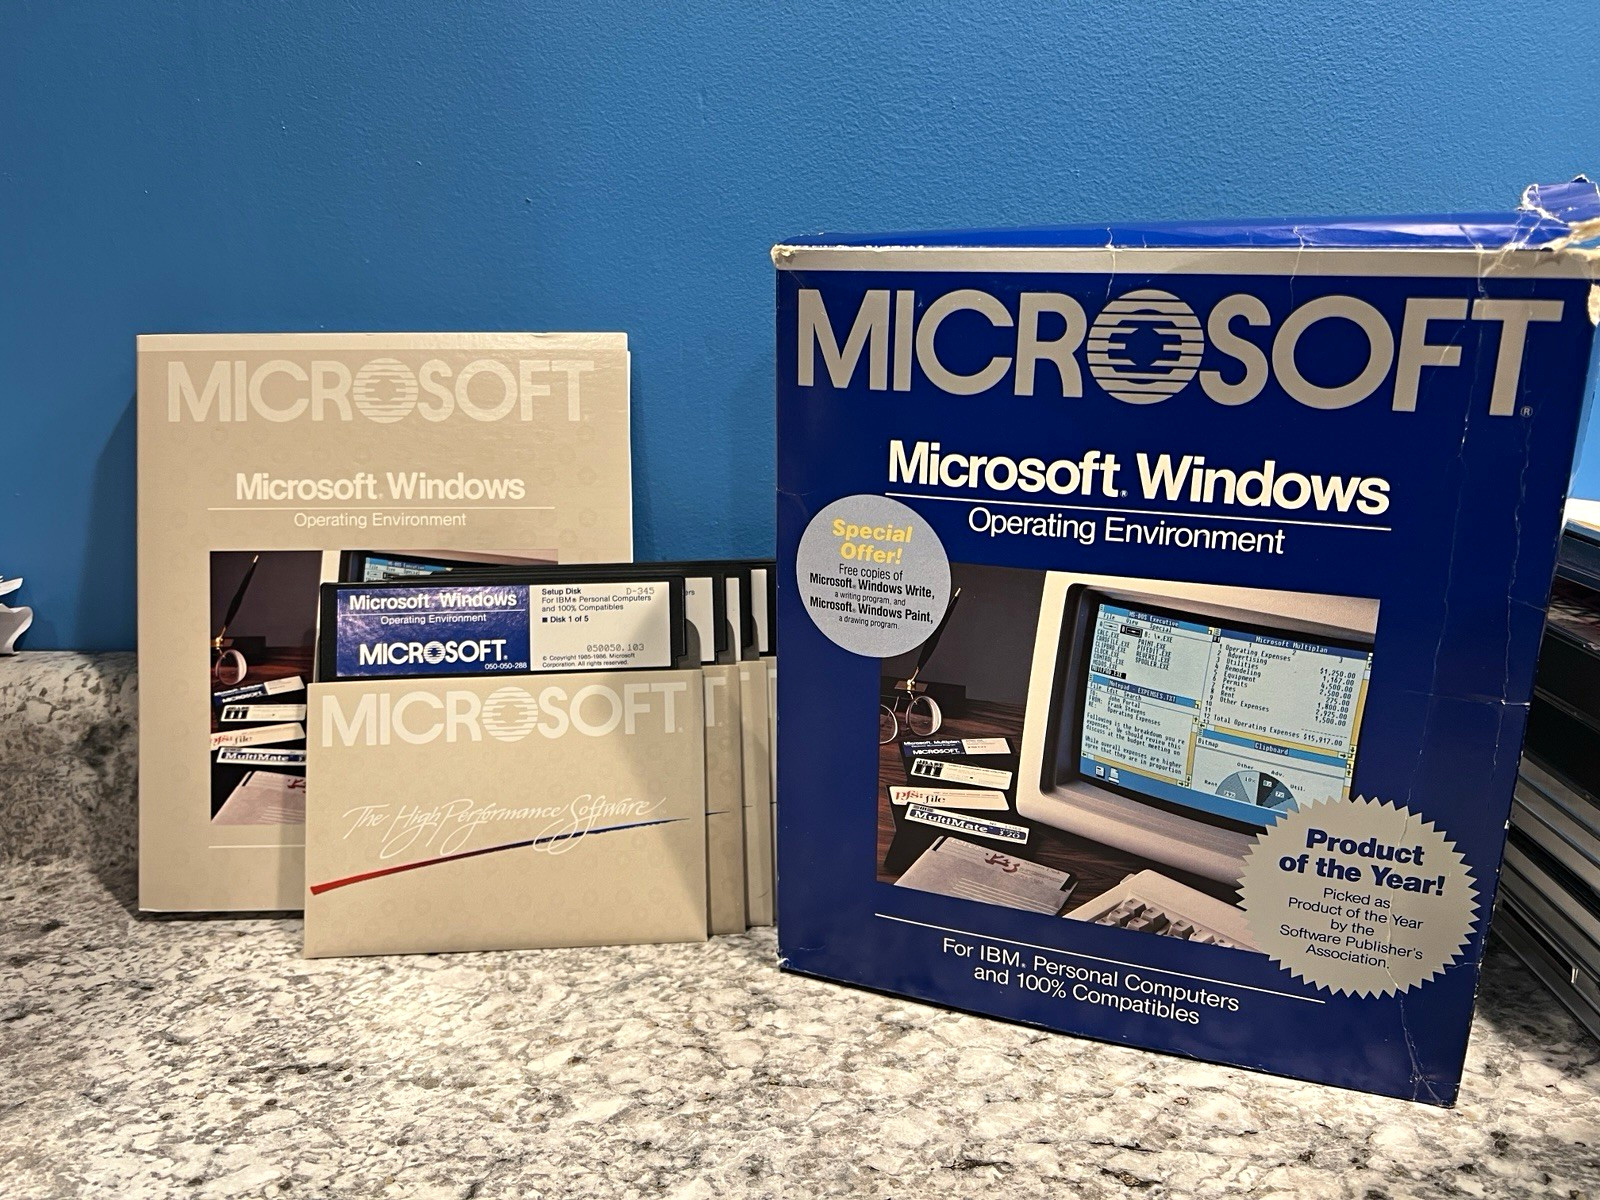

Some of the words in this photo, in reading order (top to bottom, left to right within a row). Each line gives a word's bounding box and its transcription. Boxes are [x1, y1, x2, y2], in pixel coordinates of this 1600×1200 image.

[167, 358, 595, 423] MICROSOFT
[386, 472, 526, 500] Windows
[1136, 453, 1391, 515] Windows
[294, 512, 367, 528] Operating
[372, 512, 467, 526] Environment
[832, 518, 912, 543] Special
[968, 508, 1096, 544] Operating
[1104, 517, 1286, 554] Environment
[840, 542, 903, 564] Offer!
[839, 564, 858, 576] Free
[861, 568, 890, 580] copies
[894, 570, 903, 581] of
[440, 593, 517, 607] Windows
[542, 588, 563, 596] Setup
[626, 587, 654, 595] D-345
[840, 591, 860, 601] writing
[894, 598, 906, 606] and
[858, 579, 902, 594] Windows
[905, 585, 935, 599] Write,
[381, 615, 425, 625] Operating
[429, 614, 486, 623] Environment
[844, 616, 868, 626] drawing
[870, 620, 900, 629] program.
[858, 603, 902, 619] Windows
[905, 609, 933, 623] Paint,
[1150, 616, 1179, 627] Executive
[1150, 623, 1171, 633] Special
[587, 644, 644, 652] 050050.103
[1225, 645, 1258, 657] Operating
[1261, 651, 1291, 661] Expenses
[1256, 636, 1288, 647] Microsoft
[1293, 642, 1328, 653] Multiplan
[485, 662, 527, 670] 050-050-288
[550, 654, 576, 662] Copyright
[1228, 652, 1267, 665] Advertising
[1320, 668, 1356, 679] $1,250.00
[1225, 665, 1261, 677] Remodeling
[1321, 682, 1353, 693] 4,500.00
[1226, 658, 1258, 669] Utilities
[1323, 676, 1354, 686] 1,167.00
[1124, 690, 1141, 700] Search
[1223, 677, 1247, 687] Permits
[1326, 697, 1350, 706] 275.00
[1224, 671, 1256, 683] Equipment
[1319, 689, 1351, 699] 2,500.00
[1108, 701, 1122, 709] Frank
[1125, 705, 1146, 716] Stevens
[1220, 697, 1237, 705] Other
[1240, 701, 1269, 712] Expenses
[1315, 716, 1346, 726] 1,500.00
[1221, 690, 1234, 698] Rent
[1316, 709, 1347, 720] 2,925.00
[1317, 703, 1349, 713] 1,800.00
[1087, 713, 1112, 726] Following
[1123, 722, 1132, 730] the
[1134, 725, 1162, 738] breakdown
[1107, 707, 1133, 720] Operating
[1136, 714, 1161, 726] Expenses
[1086, 725, 1105, 735] discuss
[1127, 736, 1145, 747] budget
[1148, 742, 1171, 756] meeting
[1125, 728, 1143, 740] should
[1146, 736, 1165, 746] review
[1167, 740, 1181, 750] this
[1214, 714, 1230, 724] Total
[1234, 719, 1266, 732] Operating
[1270, 727, 1299, 738] Expenses
[1304, 734, 1342, 746] $15,917.00
[1101, 740, 1121, 752] overall
[1123, 748, 1147, 759] expenses
[1162, 757, 1182, 768] higher
[1198, 738, 1218, 748] Bitmap
[1255, 742, 1289, 755] Clipboard
[225, 752, 289, 762] MultiMate
[1101, 746, 1112, 755] that
[1114, 750, 1126, 759] they
[1149, 760, 1181, 775] proportion
[1237, 762, 1253, 770] Other
[342, 804, 390, 839] The
[380, 804, 441, 859] High
[426, 799, 570, 856] Performance
[533, 794, 666, 855] Software
[914, 810, 988, 833] MultiMate
[1306, 828, 1424, 866] Product
[1279, 854, 1309, 873] of
[1316, 858, 1361, 882] the
[1371, 865, 1445, 896] Year!
[1323, 888, 1370, 906] Picked
[1375, 898, 1390, 908] as
[1289, 897, 1342, 916] Product
[1346, 908, 1359, 919] of
[1365, 910, 1387, 924] the
[1392, 914, 1423, 930] Year
[1331, 919, 1347, 933] by
[1352, 923, 1374, 936] the
[1280, 924, 1341, 945] Software
[1346, 935, 1423, 960] Publisher's
[1306, 944, 1389, 969] Association.
[943, 937, 974, 957] For
[1034, 955, 1118, 987] Personal
[1125, 974, 1239, 1012] Computers
[974, 966, 1008, 985] and
[1016, 972, 1066, 999] 100%
[1073, 984, 1200, 1024] Compatibles
